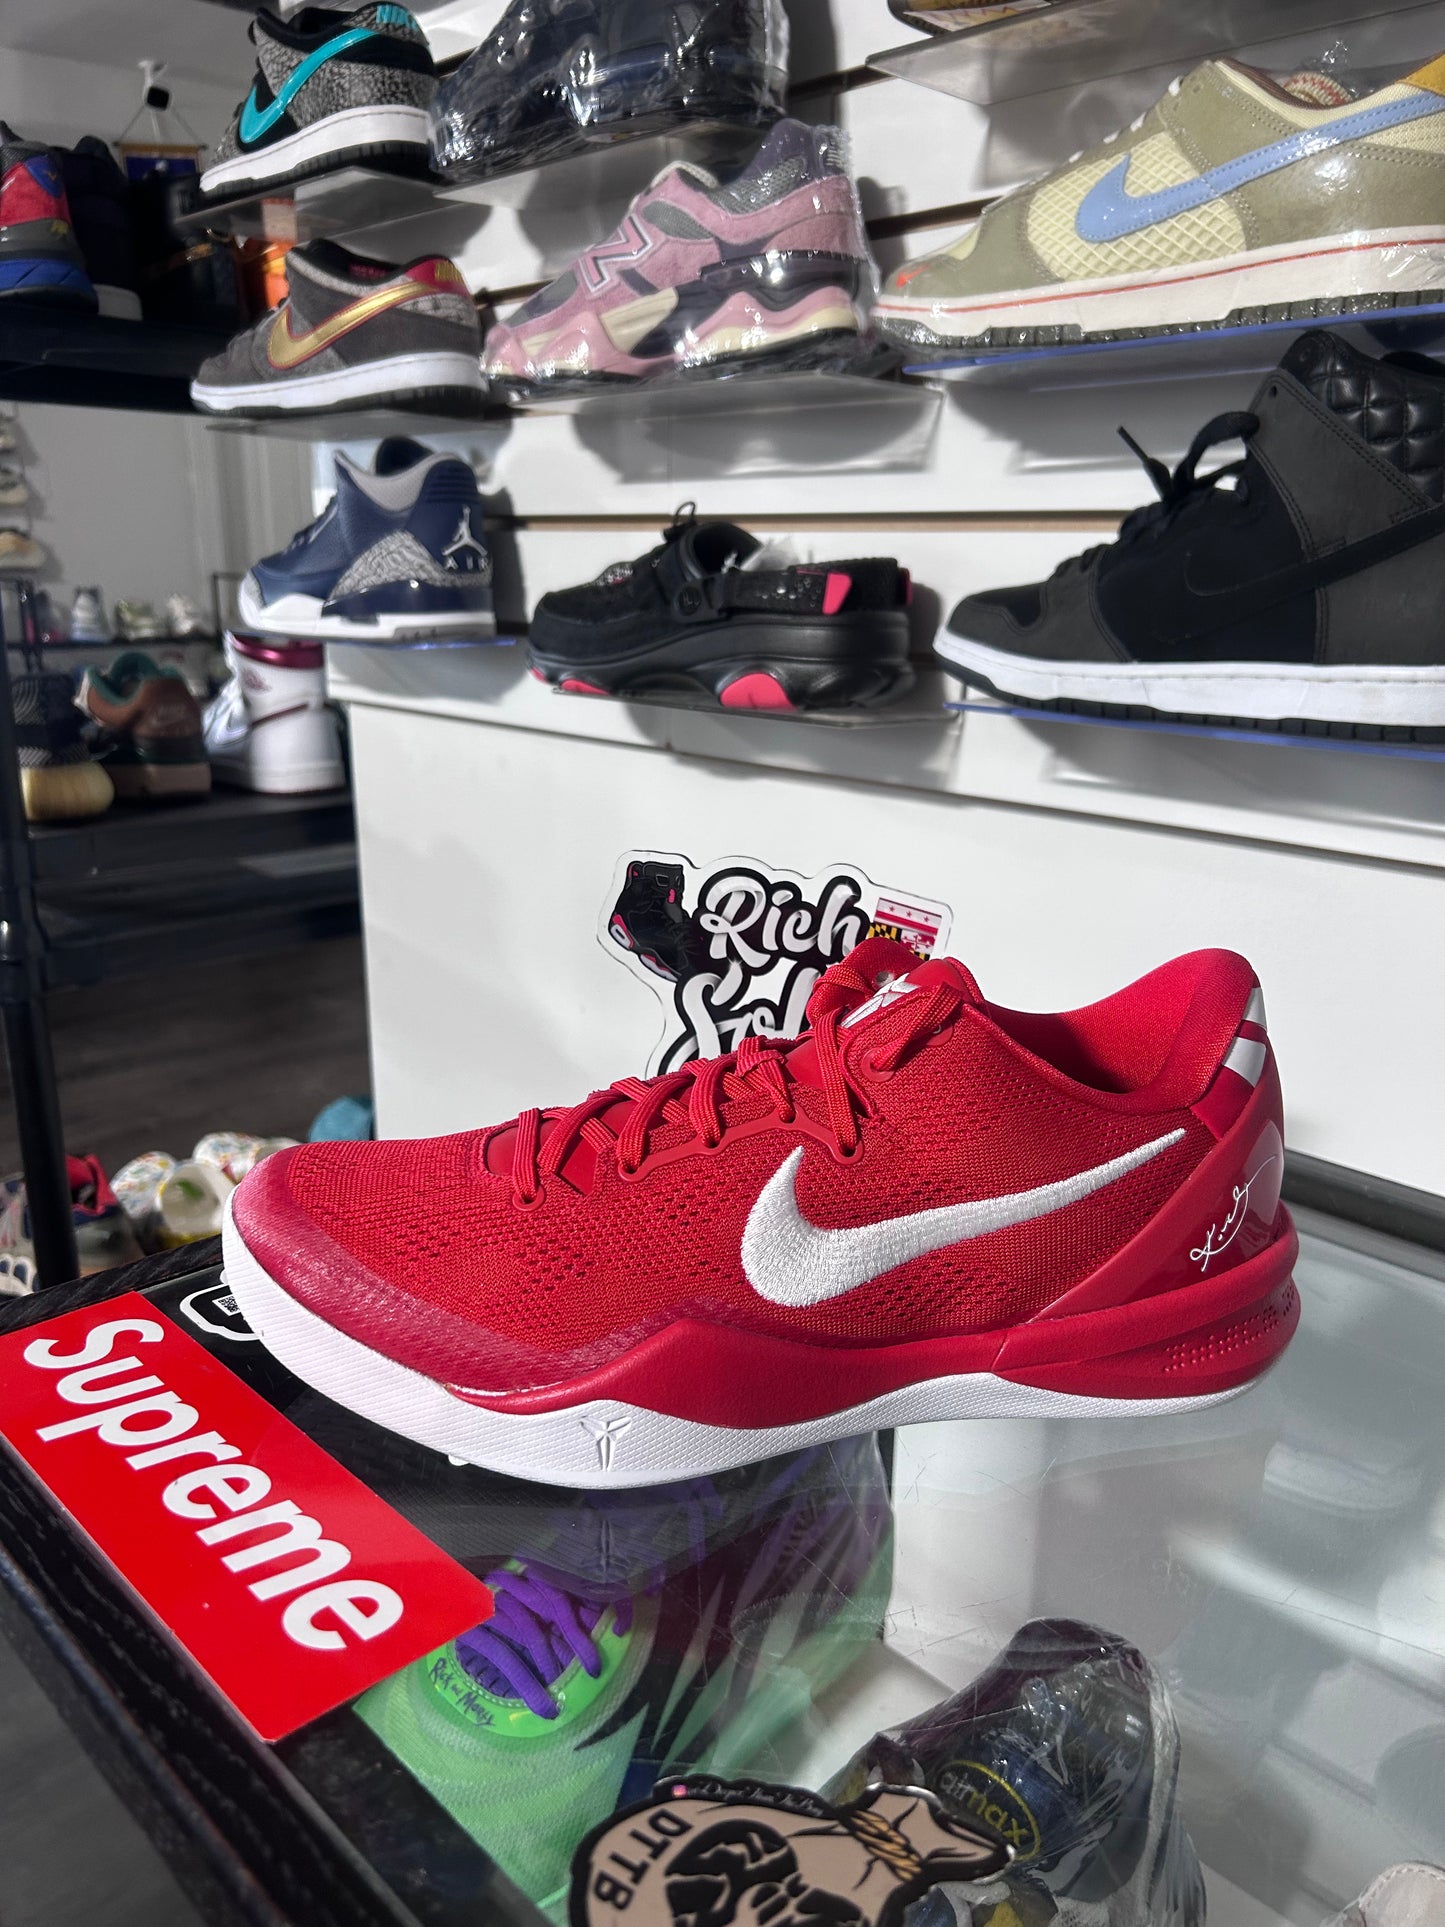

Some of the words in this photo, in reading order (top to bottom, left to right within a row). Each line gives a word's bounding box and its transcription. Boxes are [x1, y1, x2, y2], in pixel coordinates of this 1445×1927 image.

[700, 875, 862, 969] Rich
[23, 1318, 404, 1650] Supreme
[594, 1808, 694, 1911] DTTB
